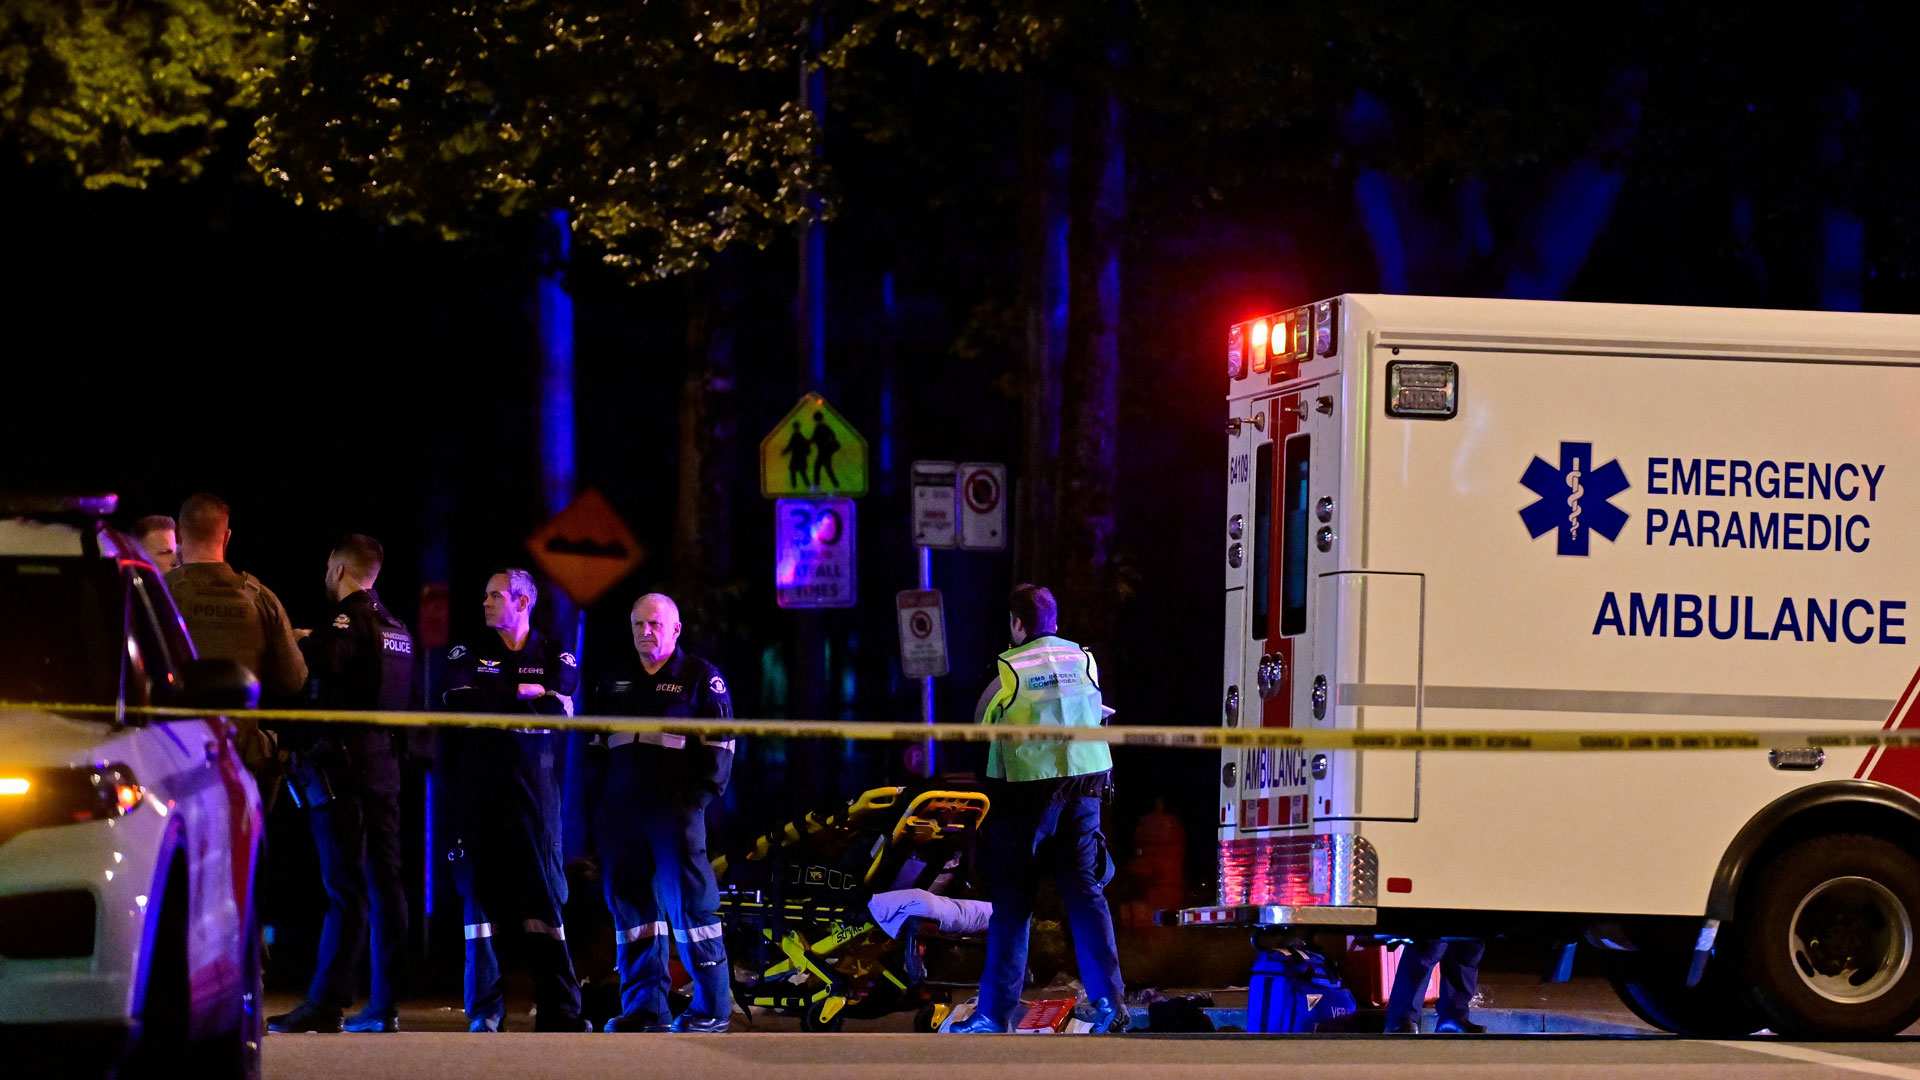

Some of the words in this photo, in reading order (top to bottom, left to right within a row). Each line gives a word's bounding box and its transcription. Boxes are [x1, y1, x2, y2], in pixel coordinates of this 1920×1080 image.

[1230, 454, 1248, 485] 64109
[1647, 457, 1886, 502] EMERGENCY
[790, 508, 843, 546] 30
[1646, 508, 1870, 553] PARAMEDIC
[815, 563, 841, 578] ALL
[194, 603, 247, 619] POLICE
[1592, 591, 1907, 645] AMBULANCE
[383, 638, 412, 654] POLICE
[655, 683, 684, 694] BCEHS
[1029, 675, 1046, 683] EMS
[1245, 747, 1307, 790] AMBULANCE
